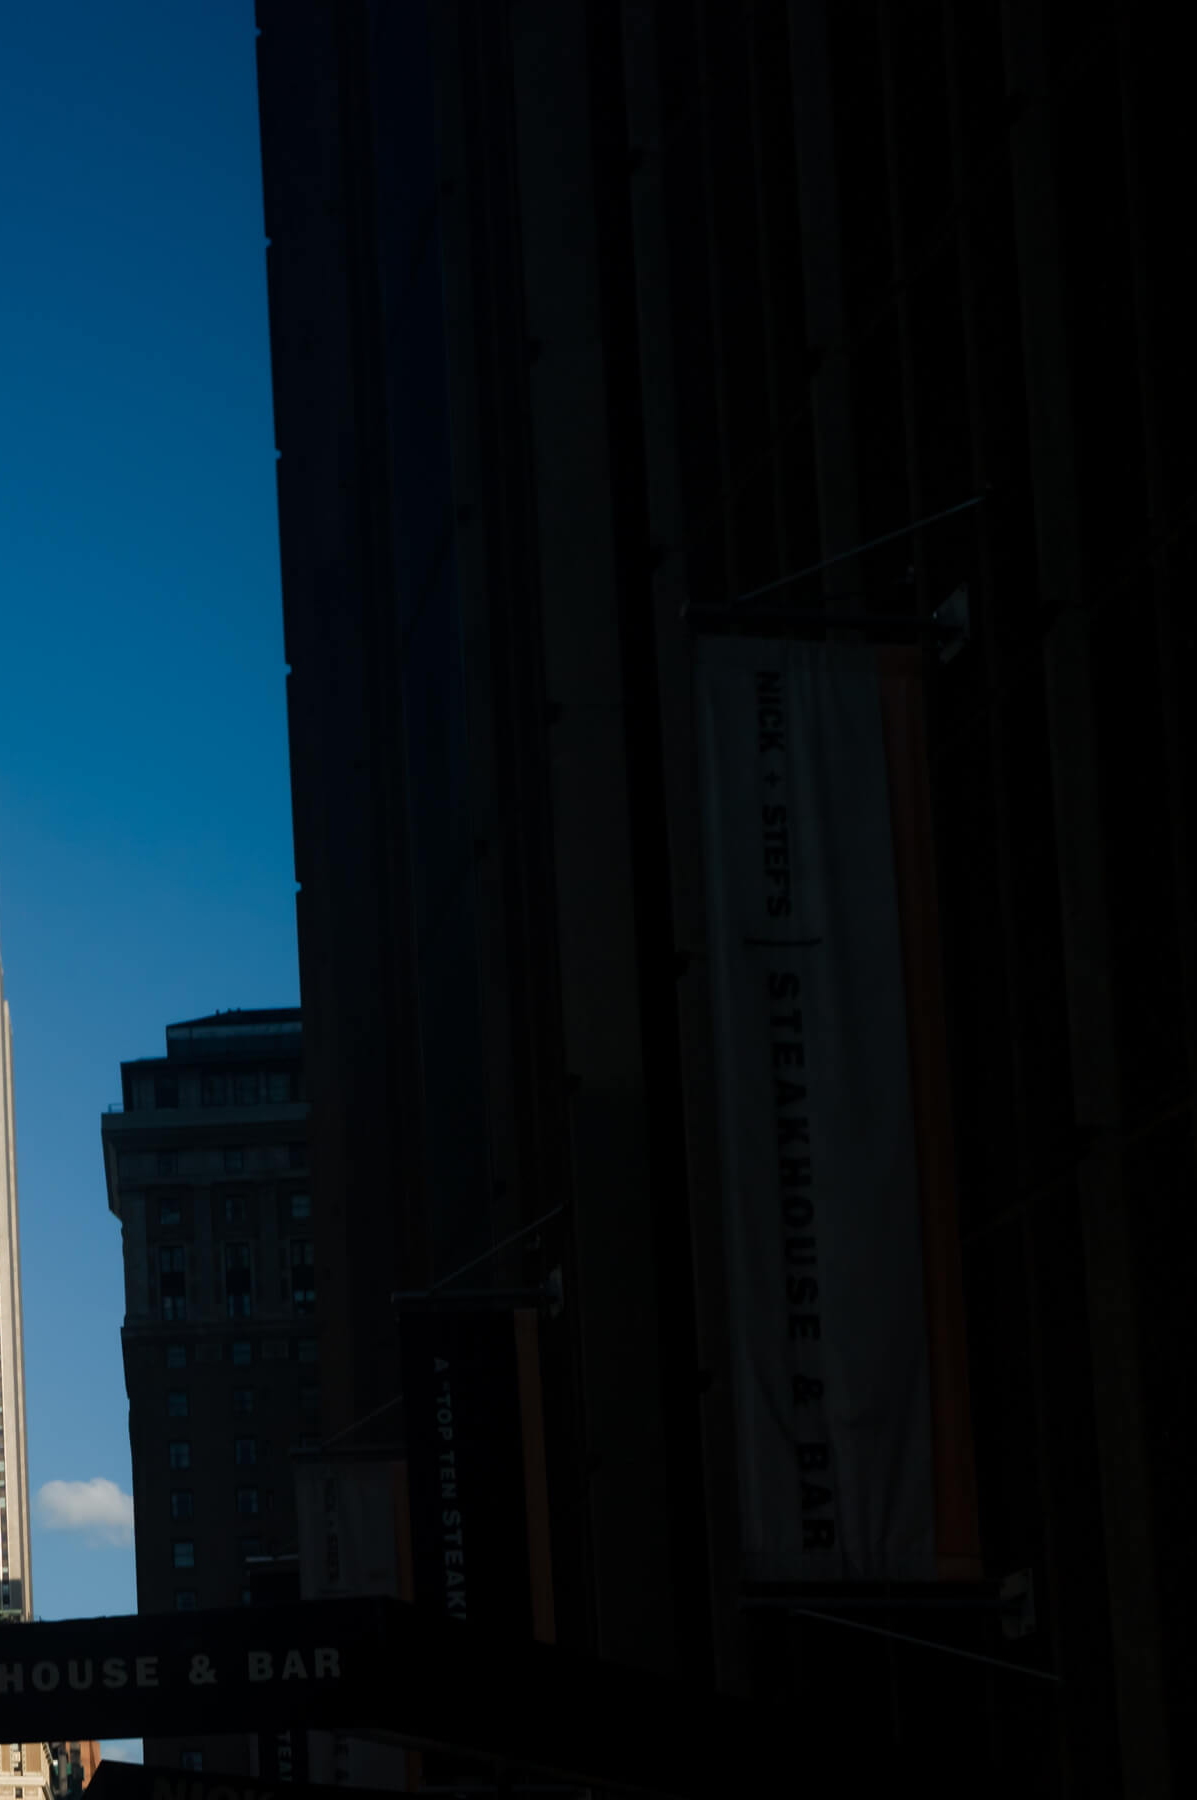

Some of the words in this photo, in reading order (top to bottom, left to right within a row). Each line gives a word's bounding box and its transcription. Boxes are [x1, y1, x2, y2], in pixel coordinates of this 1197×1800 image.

[755, 672, 786, 752] NICK
[762, 804, 791, 918] STEF'S
[767, 969, 821, 1342] STEAKHOUSE
[792, 1373, 824, 1409] &
[439, 1450, 457, 1498] TEN
[795, 1441, 835, 1553] BAR
[188, 1653, 218, 1686] &
[246, 1646, 343, 1684] BAR
